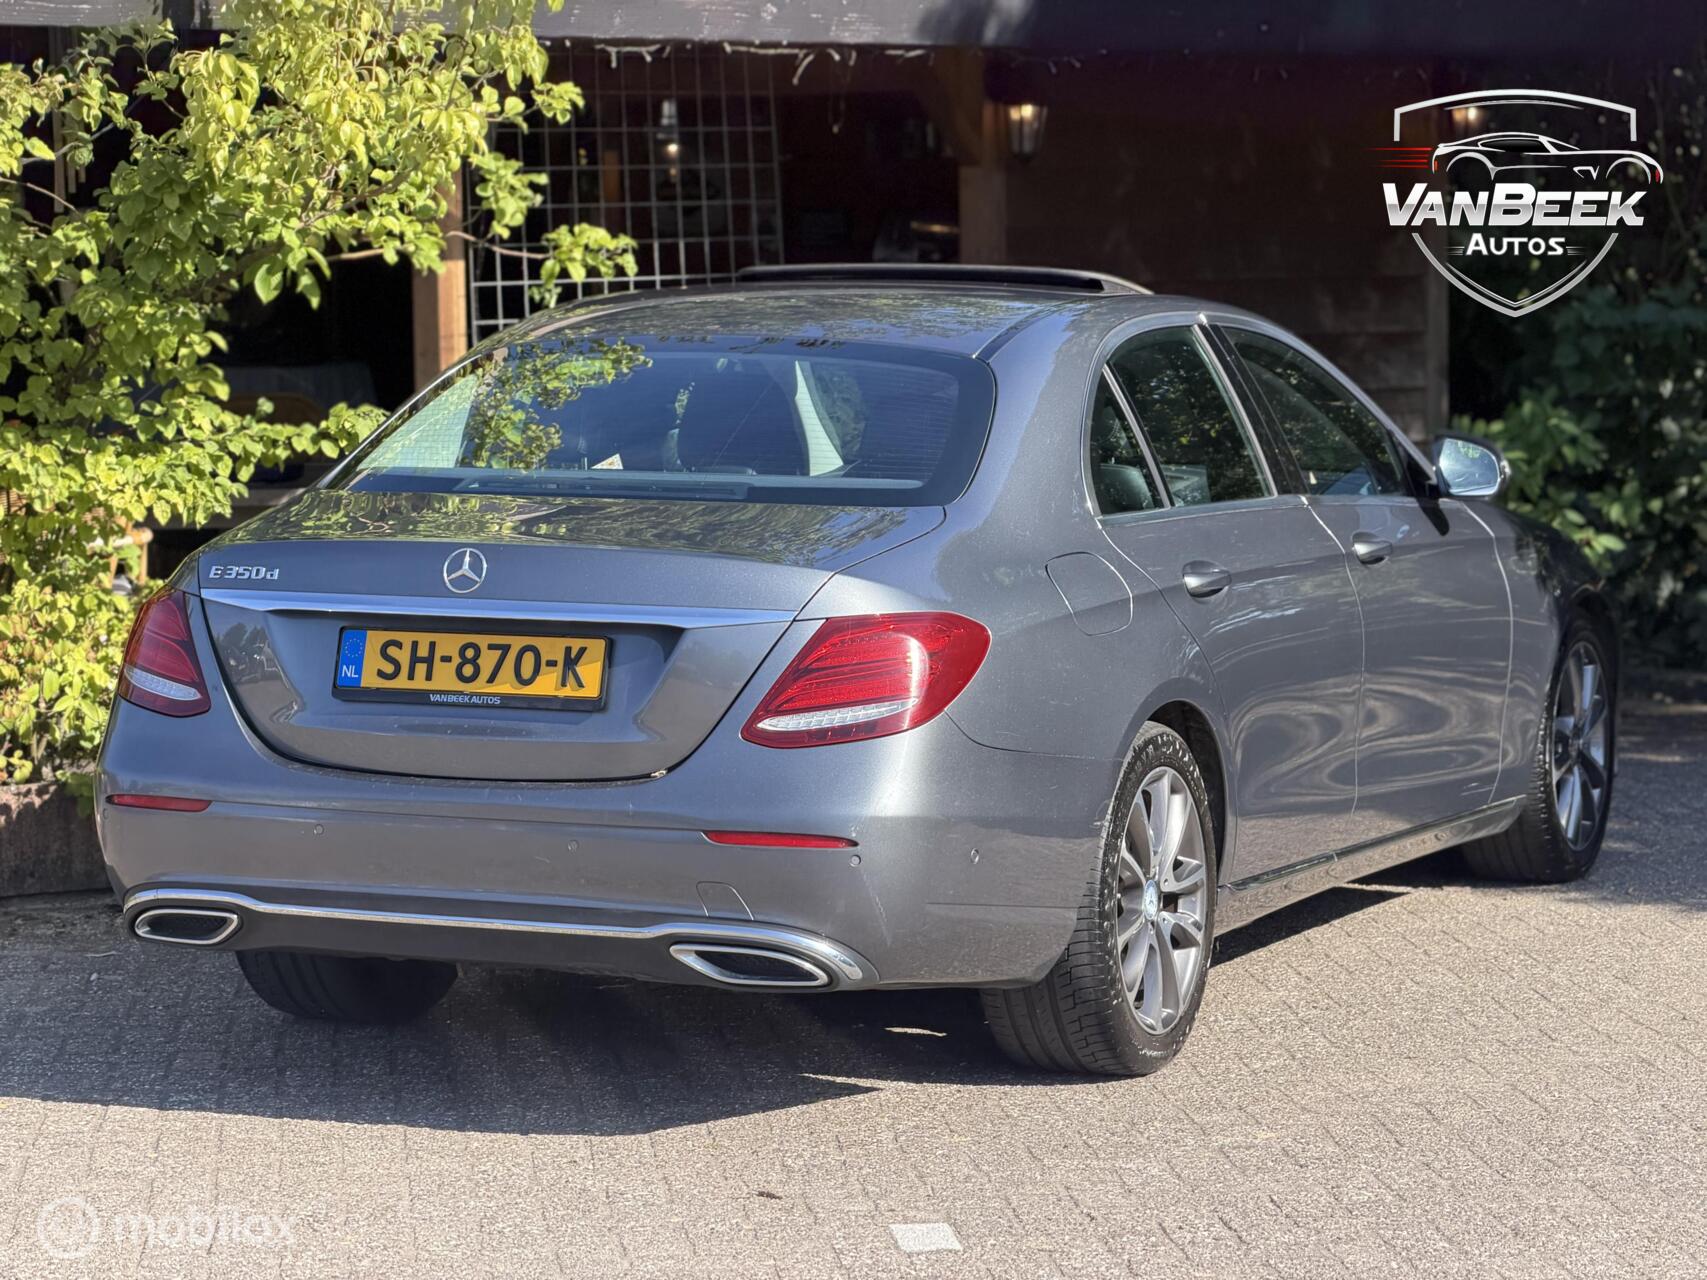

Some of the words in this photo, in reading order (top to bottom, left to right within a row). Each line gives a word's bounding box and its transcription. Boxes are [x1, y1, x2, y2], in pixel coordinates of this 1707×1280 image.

[376, 639, 588, 688] SH-870-K
[341, 664, 358, 678] NL
[470, 695, 501, 705] AUTOS
